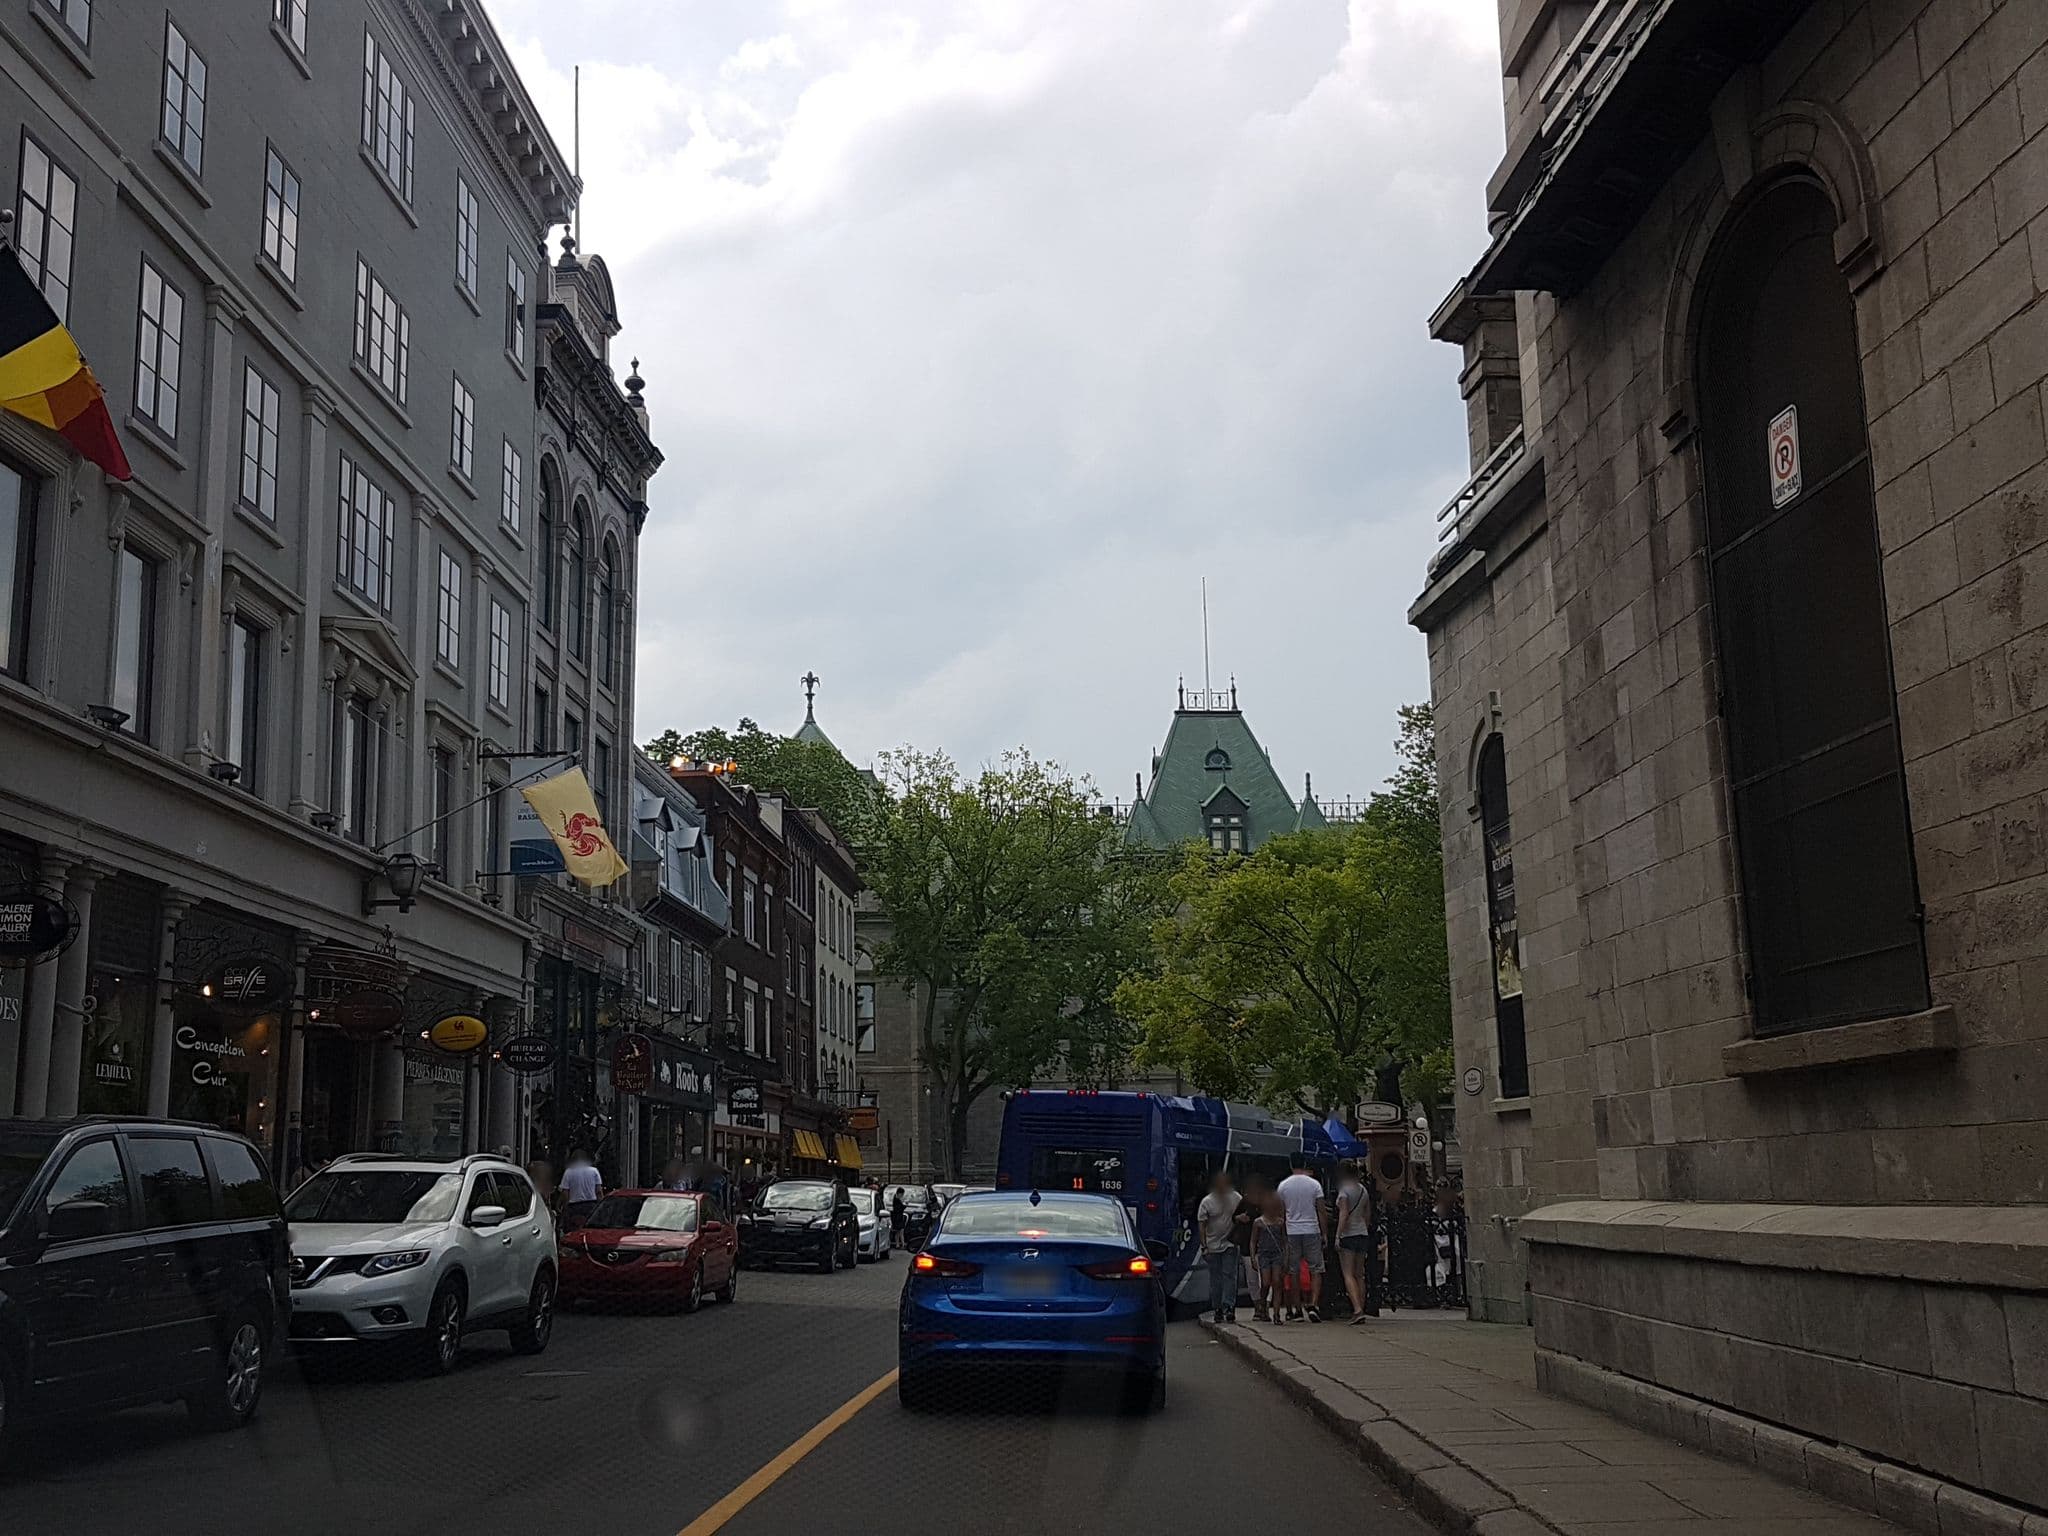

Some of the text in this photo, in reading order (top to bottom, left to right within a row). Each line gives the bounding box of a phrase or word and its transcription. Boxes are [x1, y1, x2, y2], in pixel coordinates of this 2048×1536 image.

[175, 1026, 245, 1058] Conception
[510, 1055, 546, 1063] CHANGE
[192, 1061, 226, 1087] Cuir
[675, 1062, 698, 1094] Roots
[732, 1101, 757, 1109] Roots
[1072, 1177, 1083, 1189] 11
[1100, 1180, 1122, 1190] 1636
